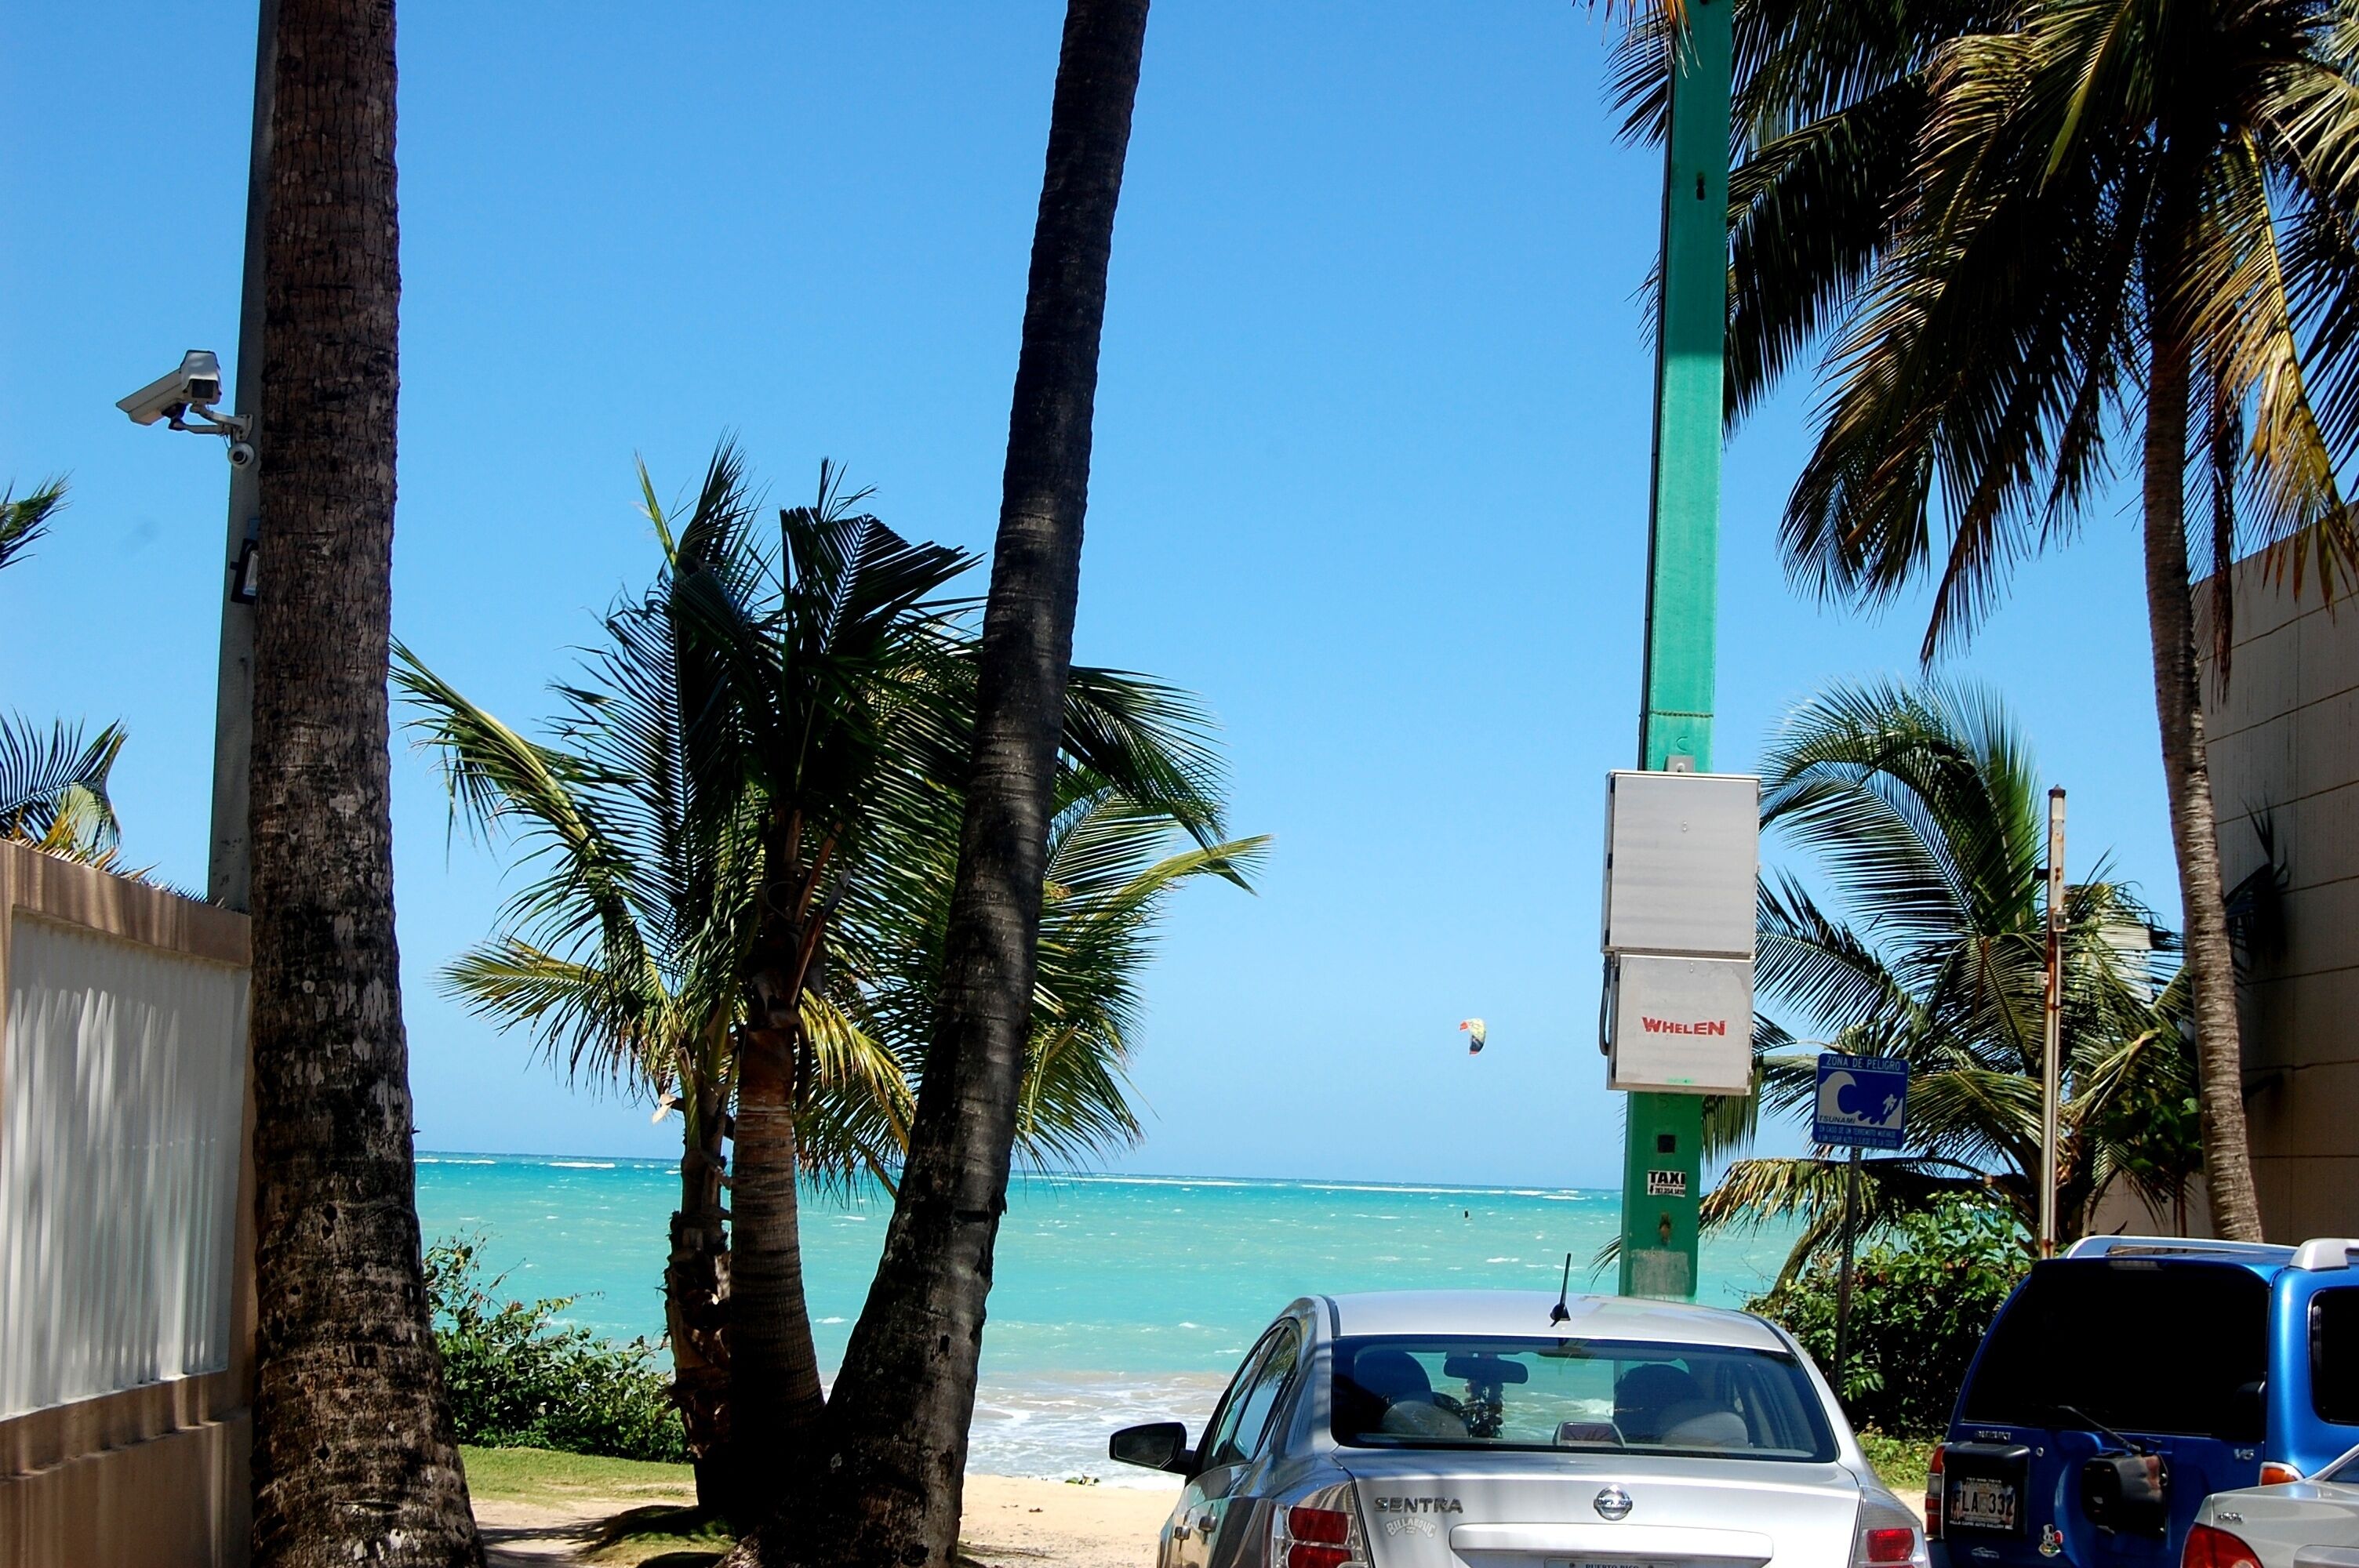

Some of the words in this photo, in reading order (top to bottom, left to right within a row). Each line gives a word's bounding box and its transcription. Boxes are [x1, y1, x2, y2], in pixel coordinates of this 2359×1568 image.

[1641, 1016, 1726, 1036] WHELEN
[1826, 1055, 1848, 1066] ZONA
[1852, 1058, 1863, 1068] DE
[1866, 1059, 1901, 1071] PELIGRO
[1819, 1115, 1856, 1124] TSUNAMI
[1648, 1171, 1685, 1185] TAXI
[1373, 1497, 1464, 1514] SENTRA
[1988, 1493, 2014, 1517] 332
